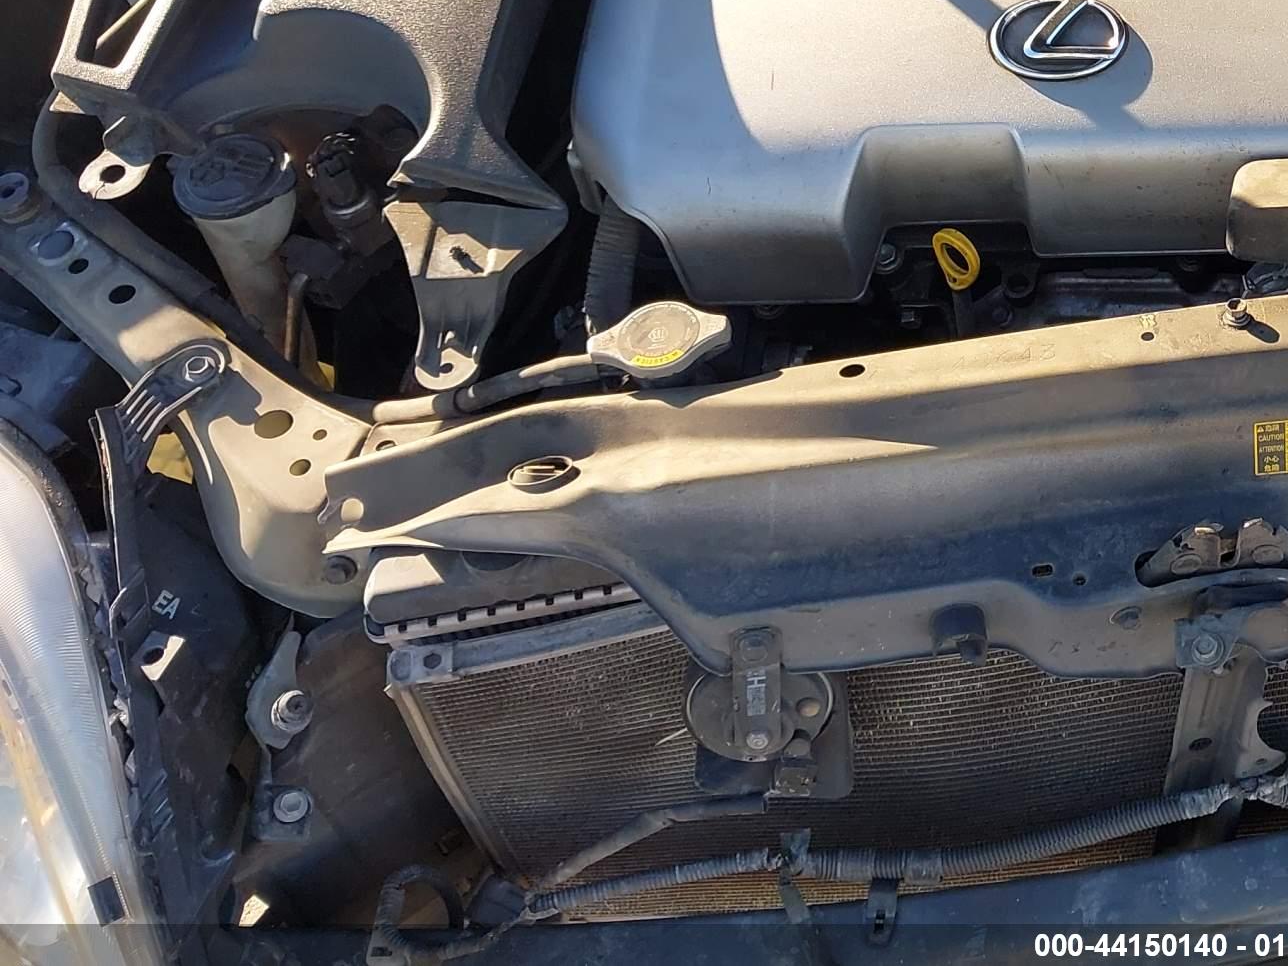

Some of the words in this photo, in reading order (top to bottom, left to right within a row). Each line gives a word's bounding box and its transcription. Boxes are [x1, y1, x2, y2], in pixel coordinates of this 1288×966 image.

[1258, 433, 1284, 442] CAUTION
[1259, 444, 1284, 453] ATTENTION
[151, 589, 180, 620] EA
